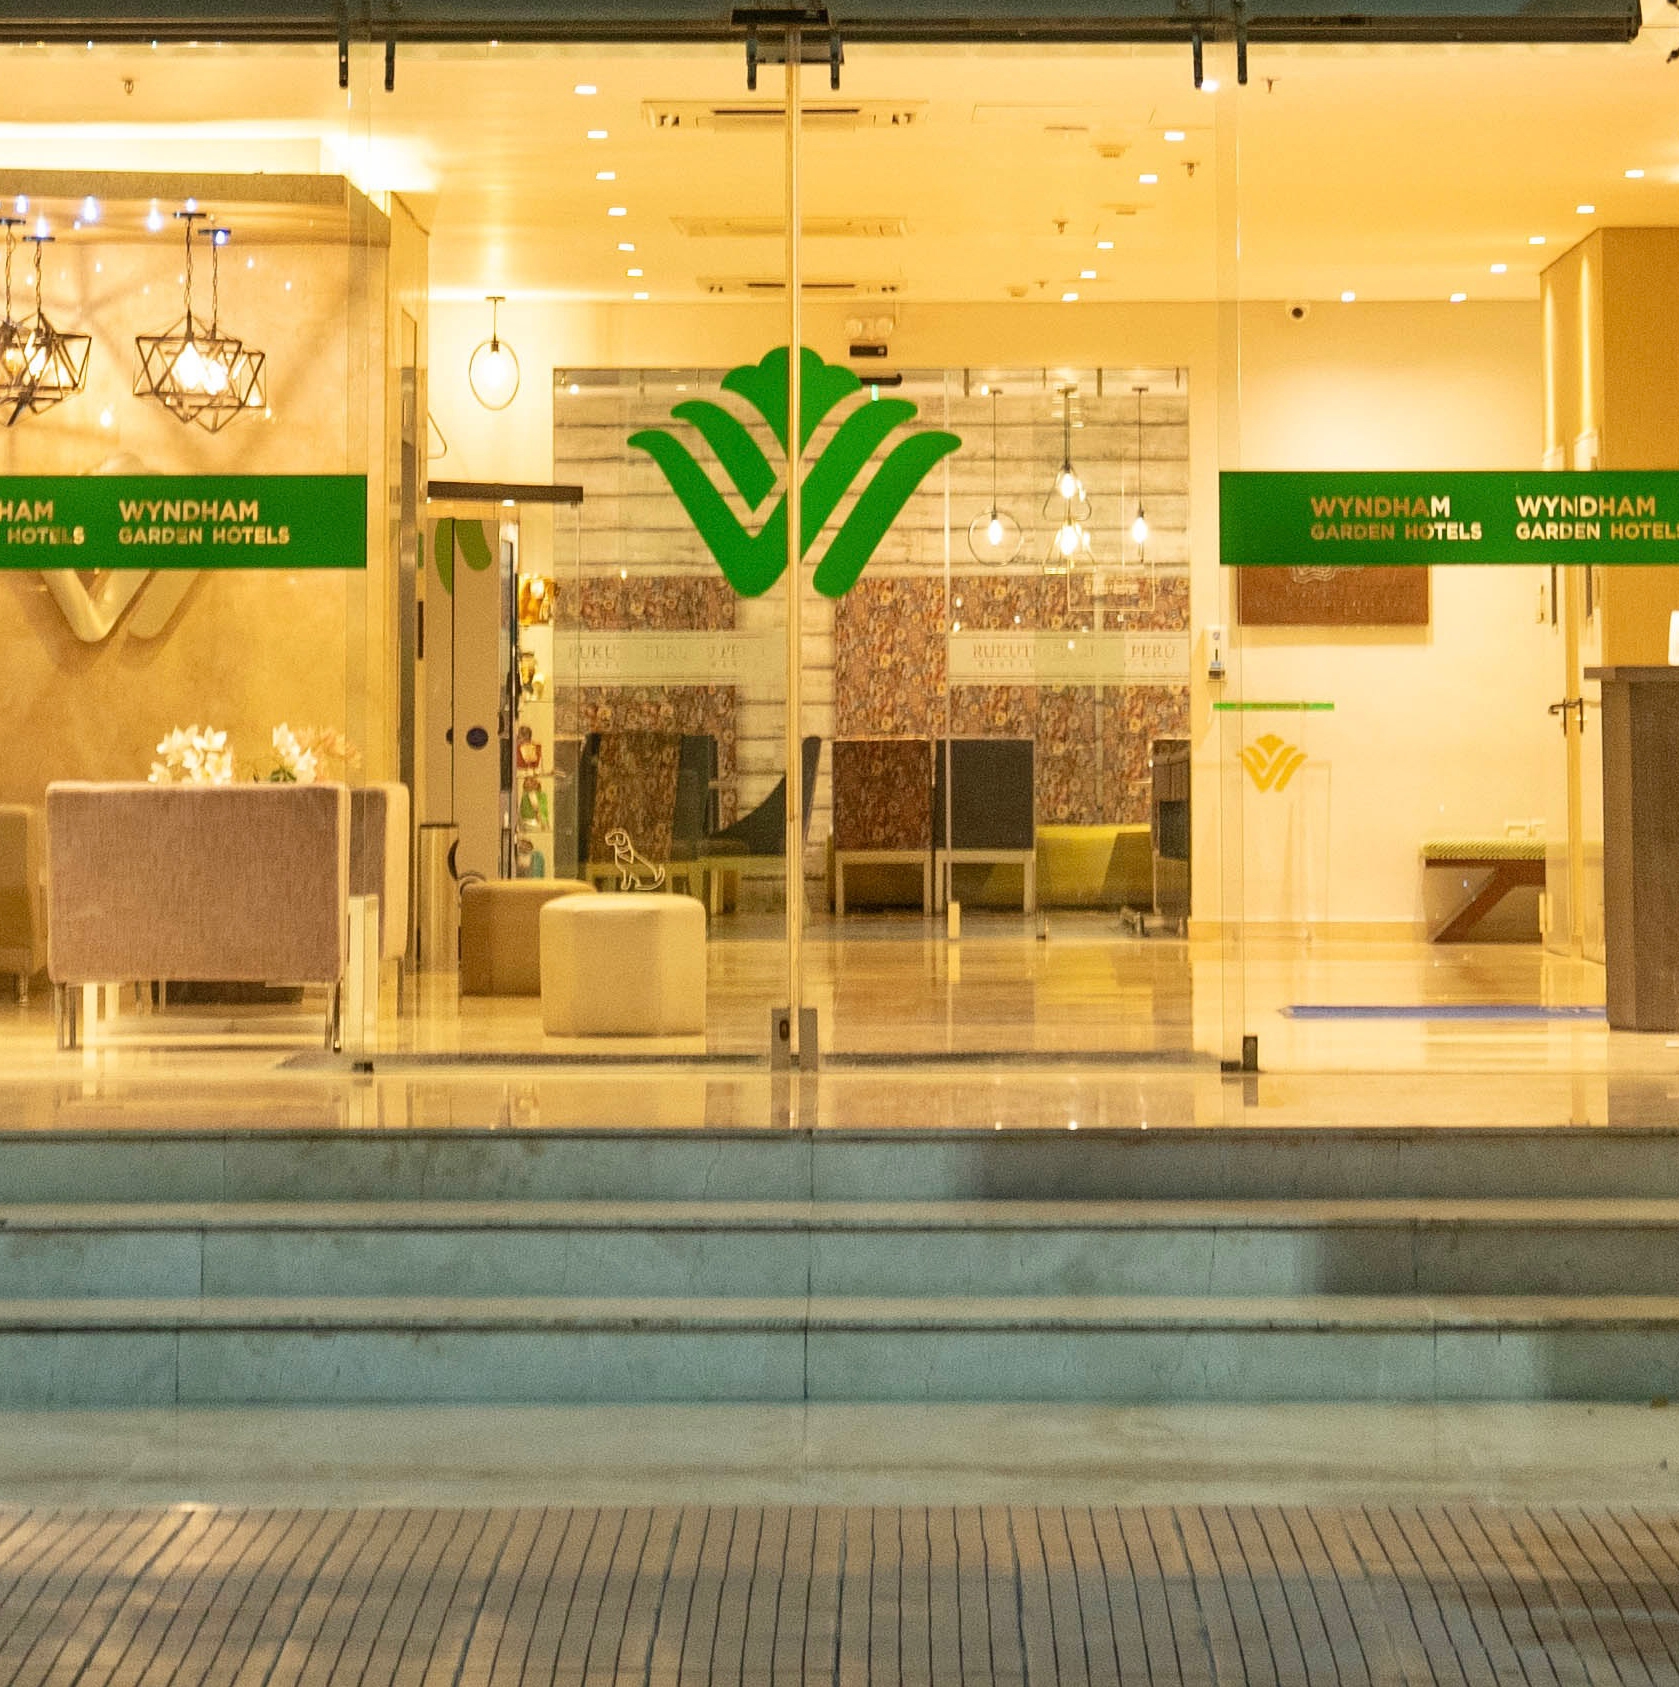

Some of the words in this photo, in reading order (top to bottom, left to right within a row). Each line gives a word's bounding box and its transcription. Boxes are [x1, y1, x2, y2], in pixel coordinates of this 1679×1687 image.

[118, 499, 259, 522] WYNDHAM
[1310, 495, 1451, 518] WYNDHAM
[1516, 495, 1657, 518] WYNDHAM
[8, 526, 86, 544] HOTELS
[118, 526, 204, 544] GARDEN
[213, 526, 291, 544] HOTELS
[1310, 522, 1396, 540] GARDEN
[1405, 522, 1483, 540] HOTELS
[1516, 522, 1602, 540] GARDEN
